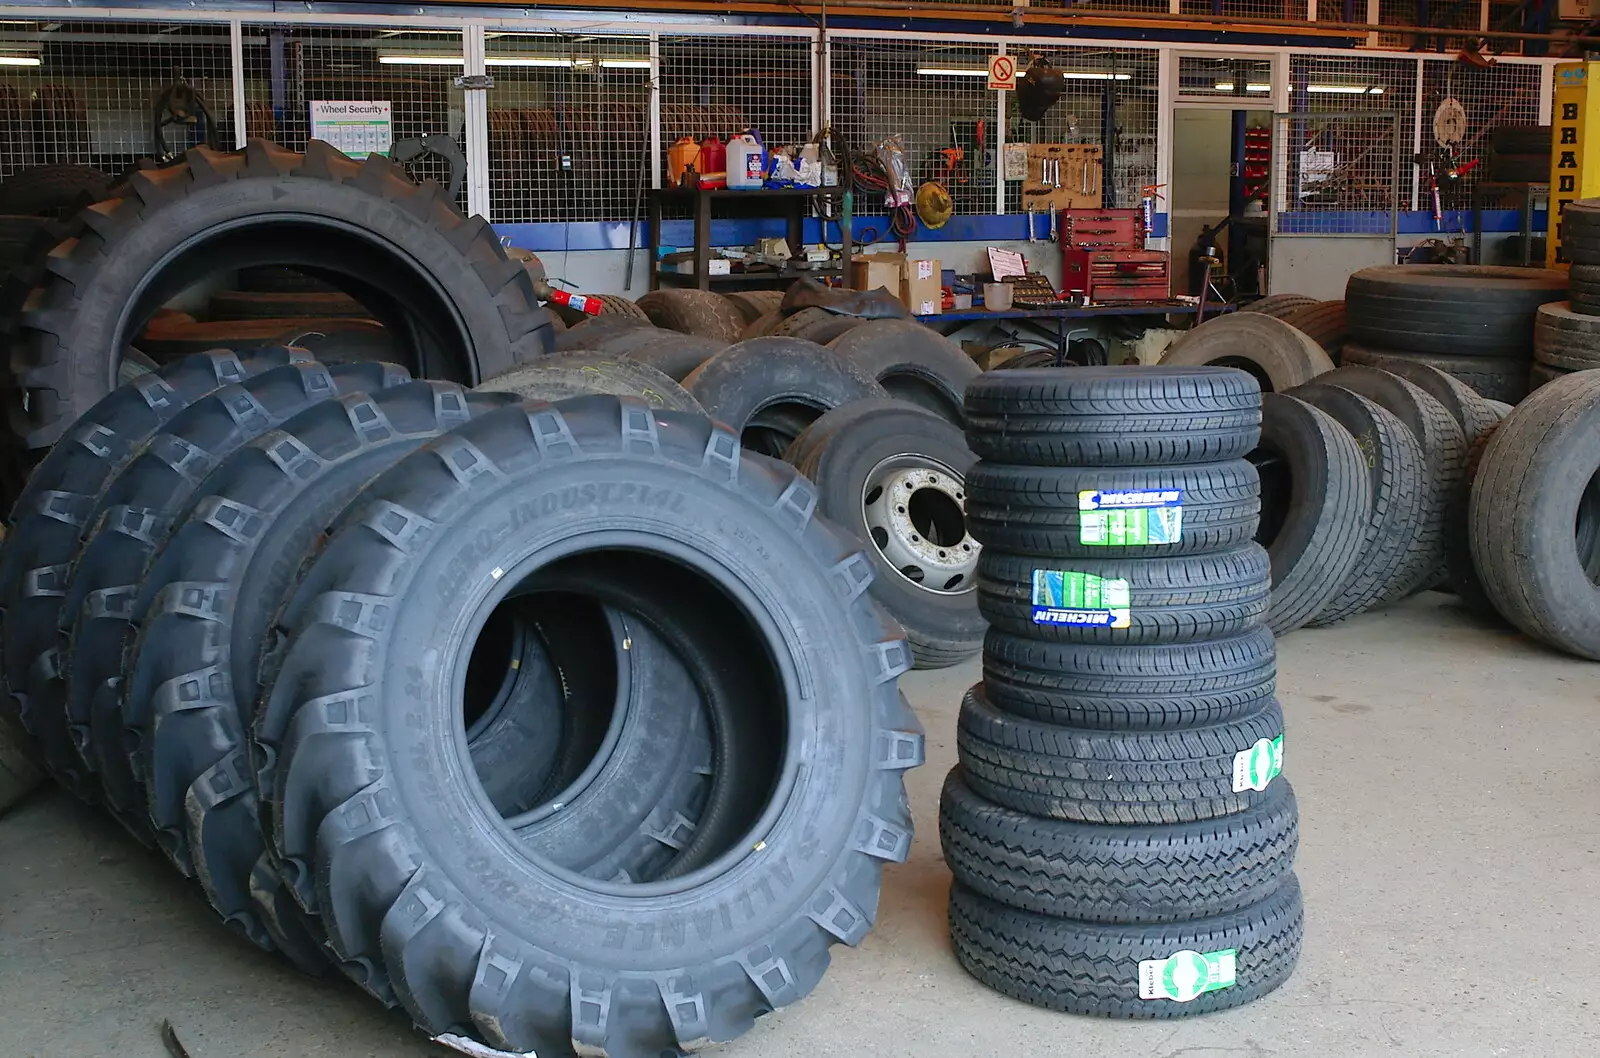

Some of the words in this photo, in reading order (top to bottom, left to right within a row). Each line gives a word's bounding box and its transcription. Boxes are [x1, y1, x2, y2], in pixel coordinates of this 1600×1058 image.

[320, 105, 346, 114] Wheel
[349, 104, 382, 115] Security
[1099, 491, 1180, 504] MICHELIN
[1034, 611, 1110, 624] MICHELIN
[602, 856, 797, 952] ALLIANCE
[1147, 964, 1155, 995] Kleber
